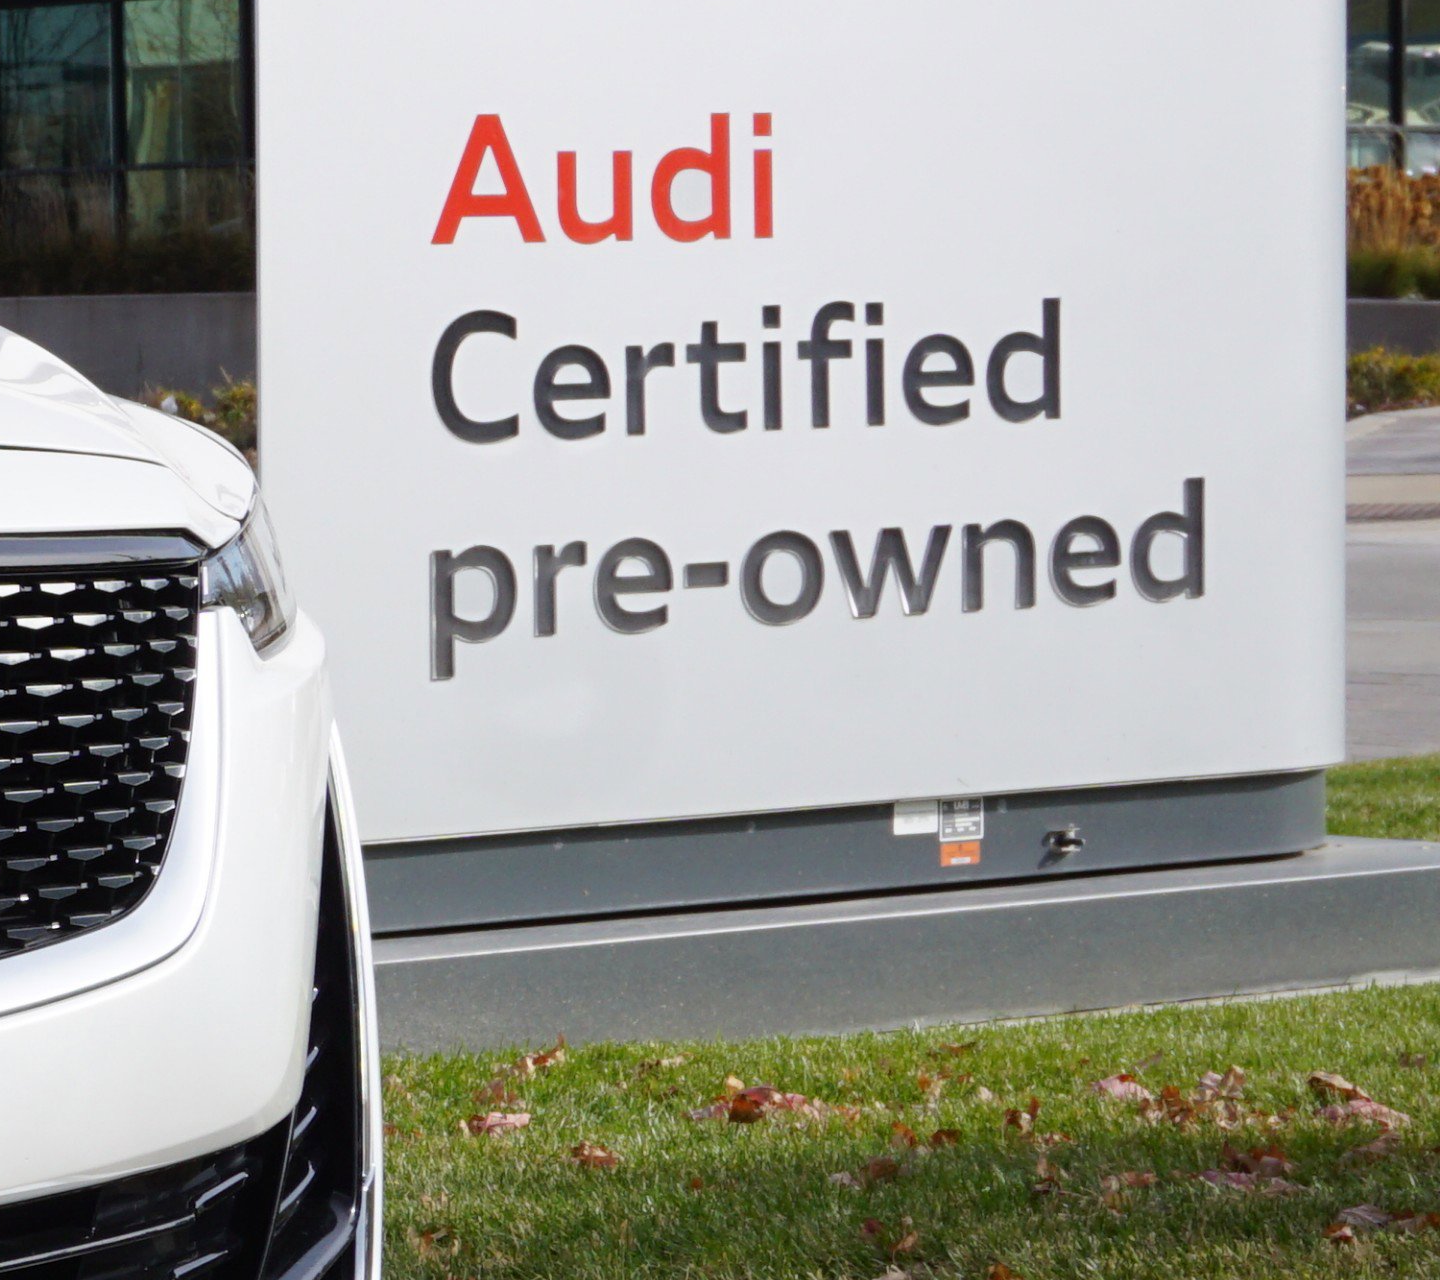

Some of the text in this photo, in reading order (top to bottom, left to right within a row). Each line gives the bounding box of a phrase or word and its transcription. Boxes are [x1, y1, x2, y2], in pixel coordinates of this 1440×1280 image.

[430, 112, 774, 245] Audi
[432, 297, 1062, 443] Certified
[430, 477, 1206, 681] pre-owned
